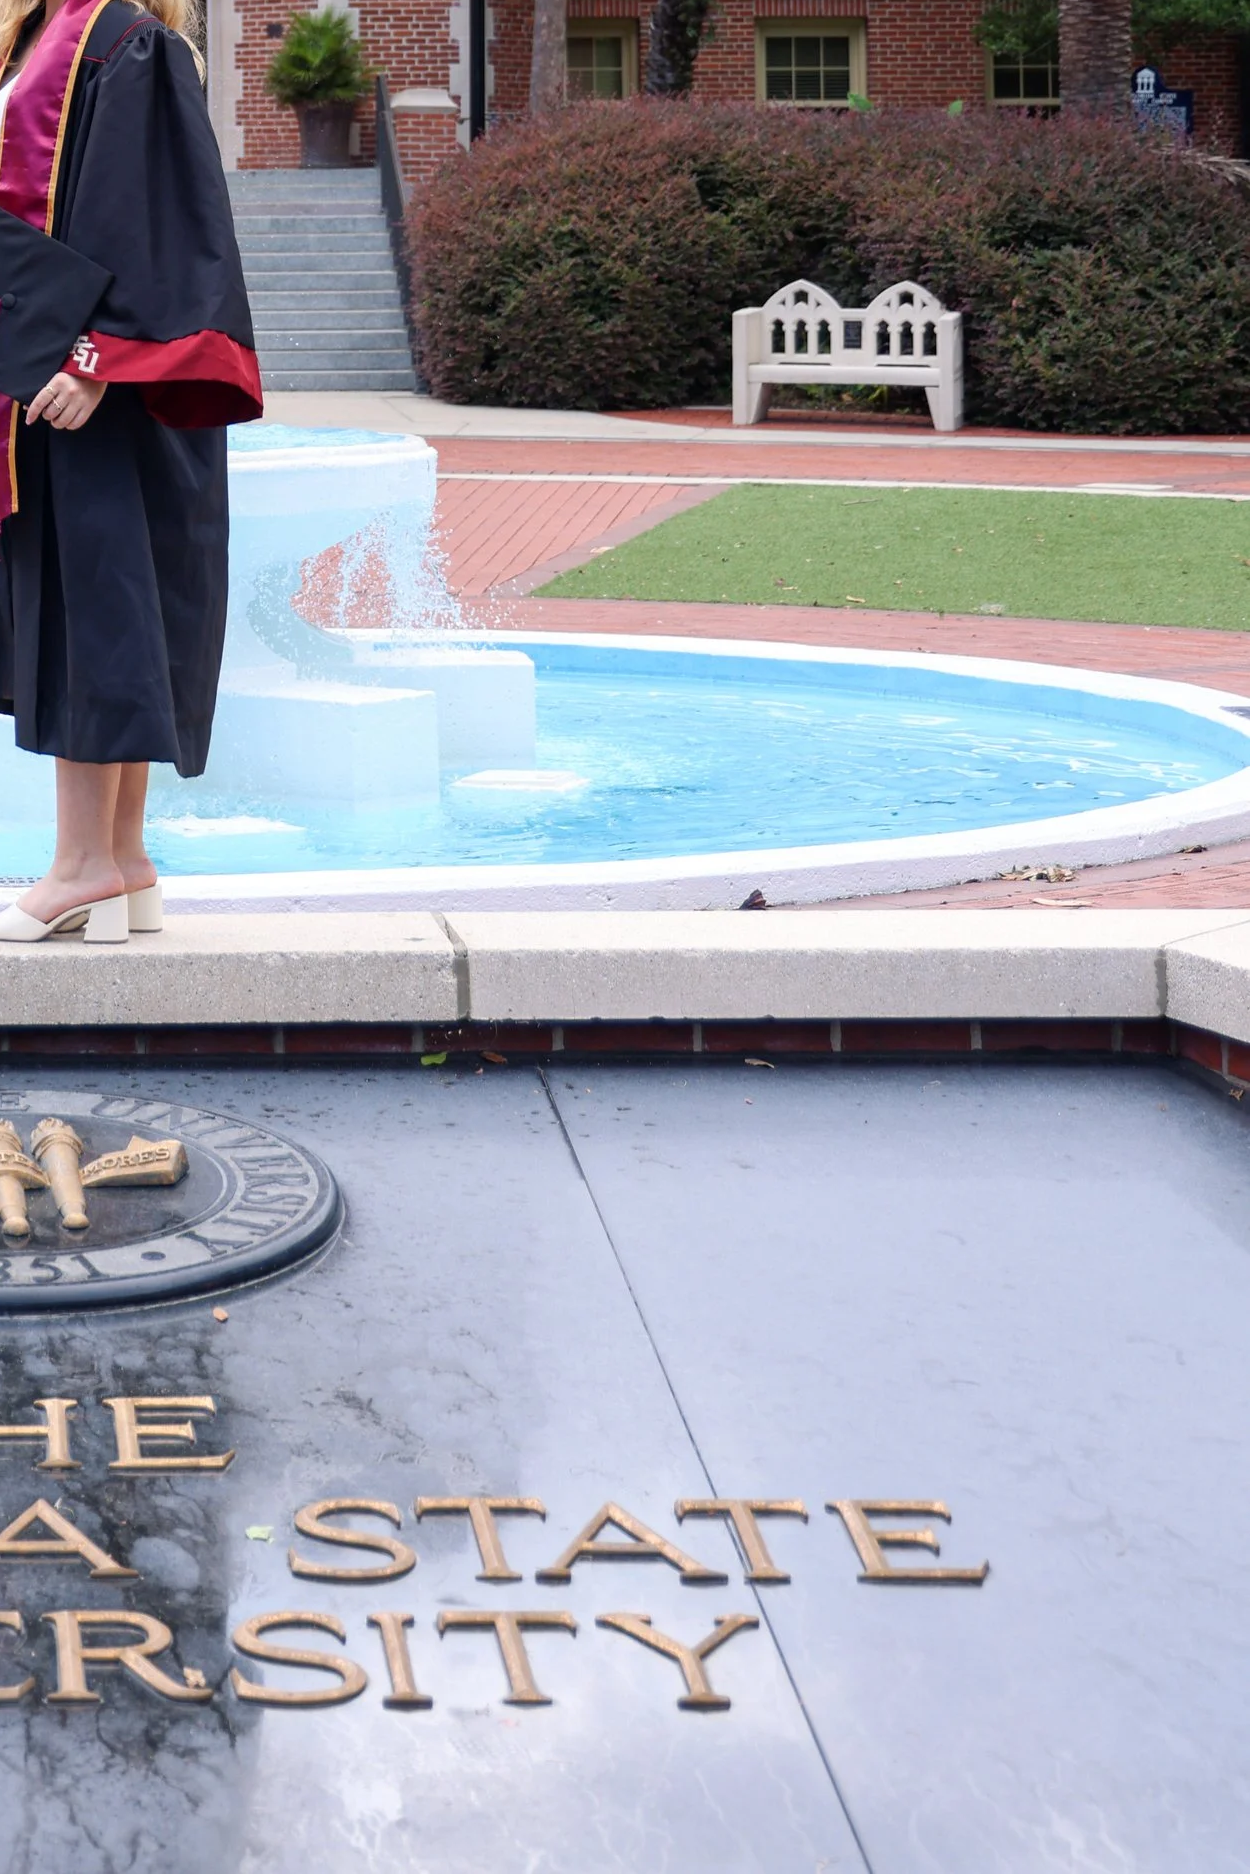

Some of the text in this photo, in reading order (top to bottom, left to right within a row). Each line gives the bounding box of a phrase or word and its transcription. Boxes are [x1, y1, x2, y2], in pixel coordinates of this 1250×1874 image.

[70, 335, 99, 374] FSU
[81, 1148, 170, 1176] MORES
[91, 1096, 310, 1261] UNIVERSITY
[287, 1497, 990, 1585] STATE
